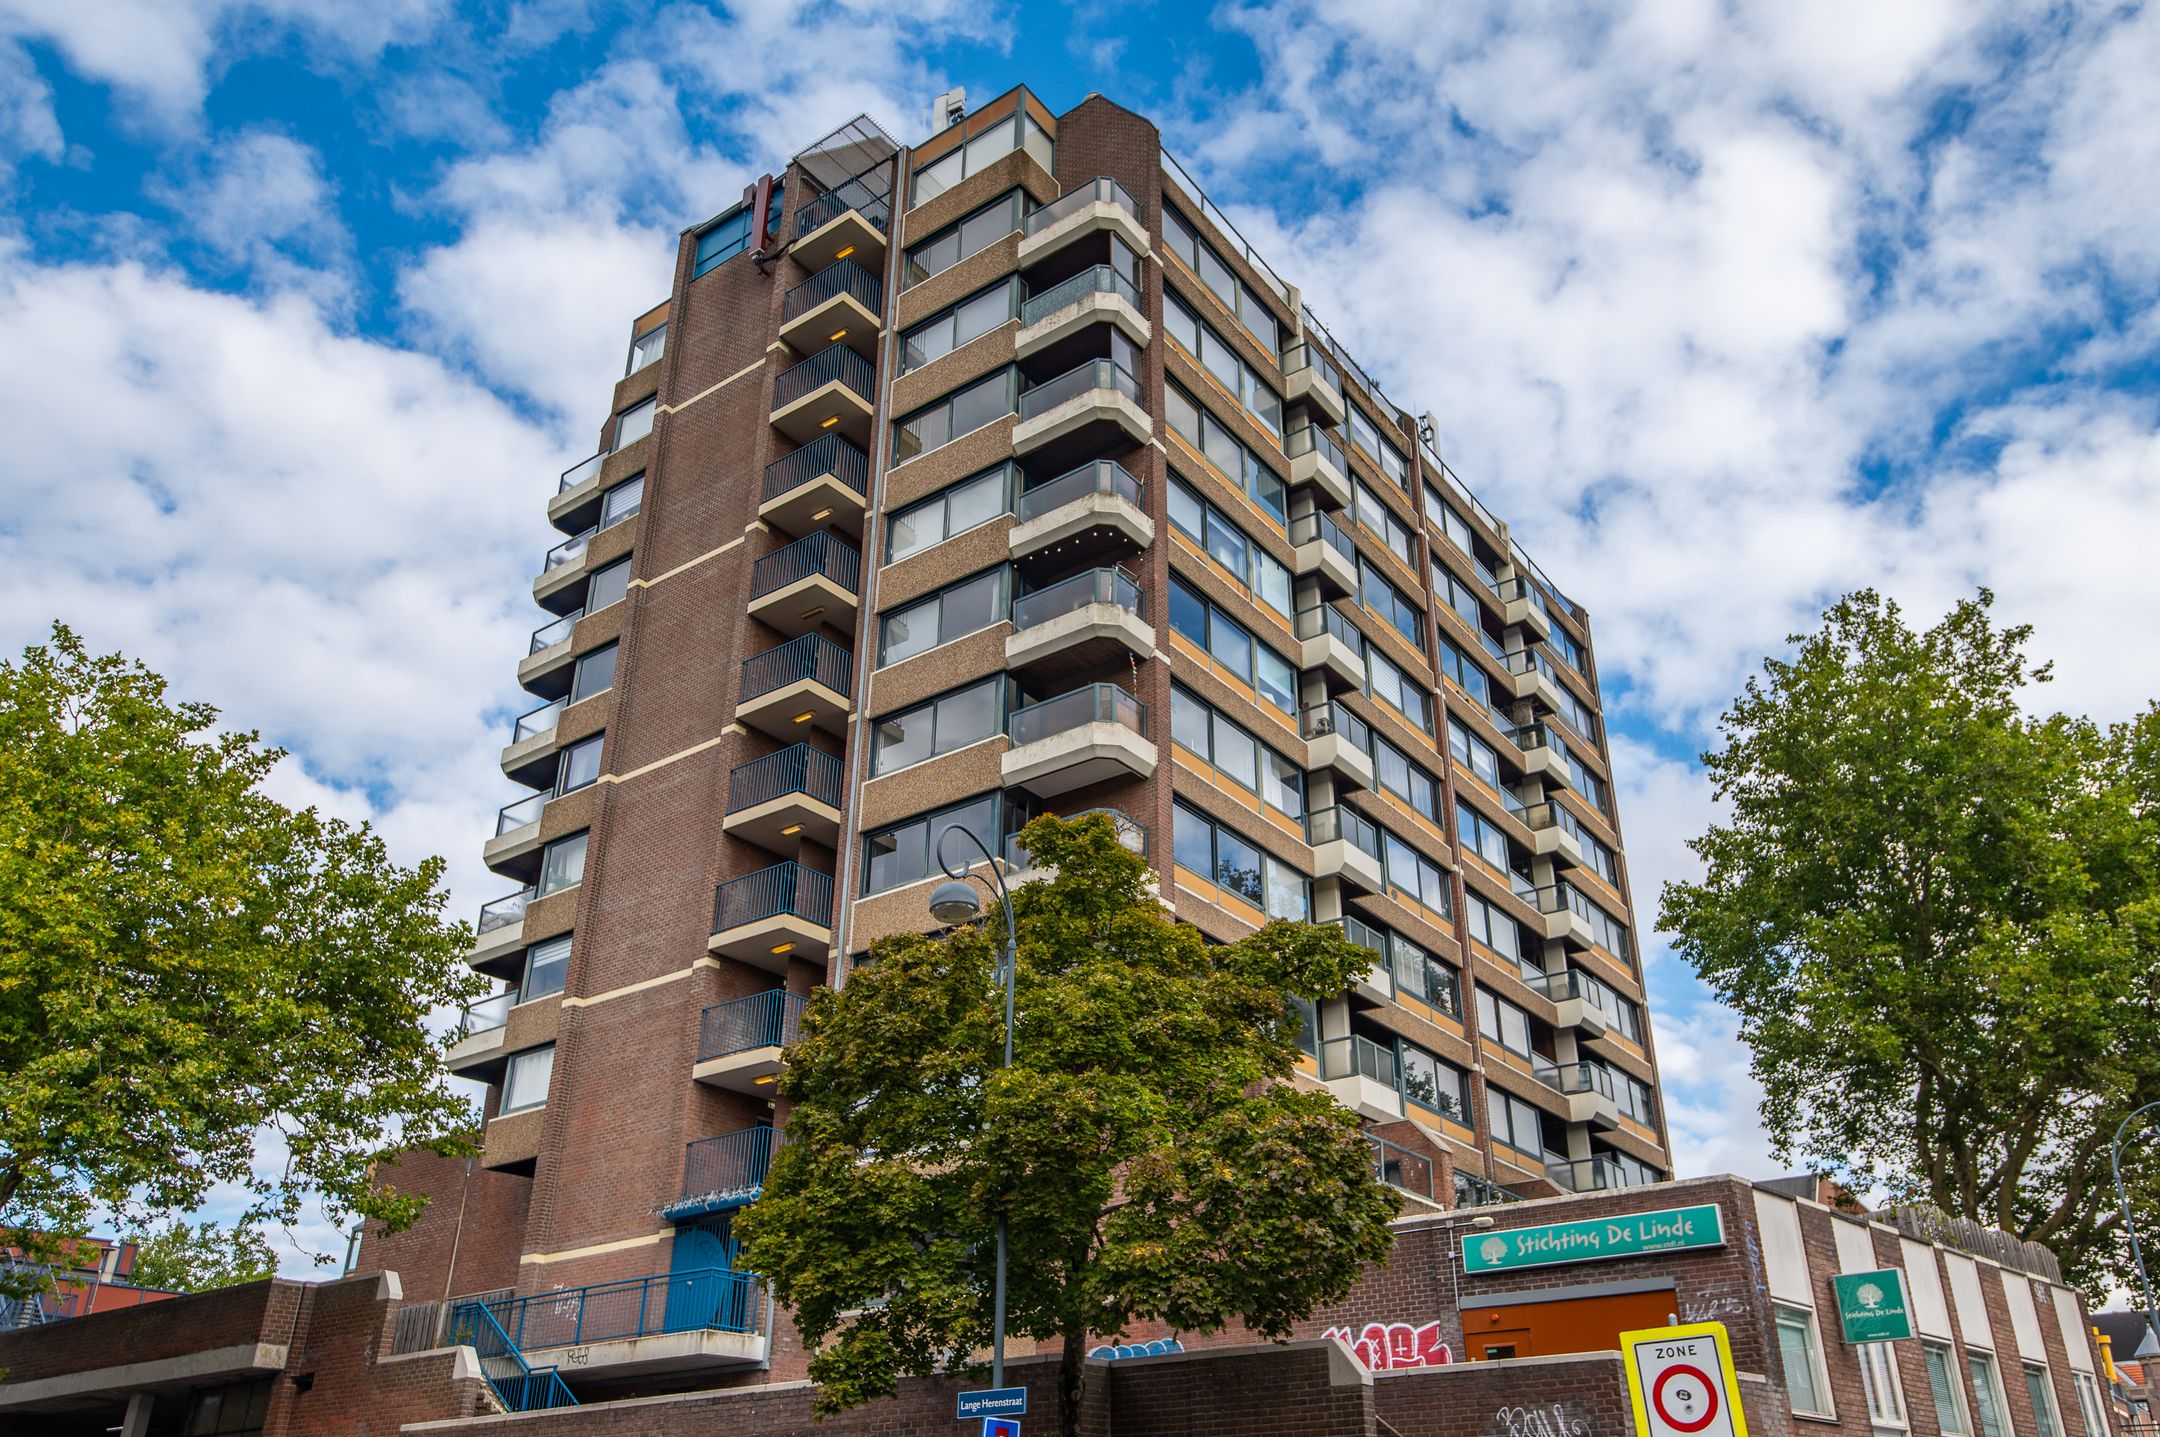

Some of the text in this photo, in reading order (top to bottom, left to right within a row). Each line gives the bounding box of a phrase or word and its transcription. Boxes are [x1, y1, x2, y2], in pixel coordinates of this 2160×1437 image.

[1515, 1214, 1694, 1257] Stichting De Linde
[1655, 1345, 1697, 1359] ZONE
[960, 1397, 1023, 1413] Lange Herenstraat
